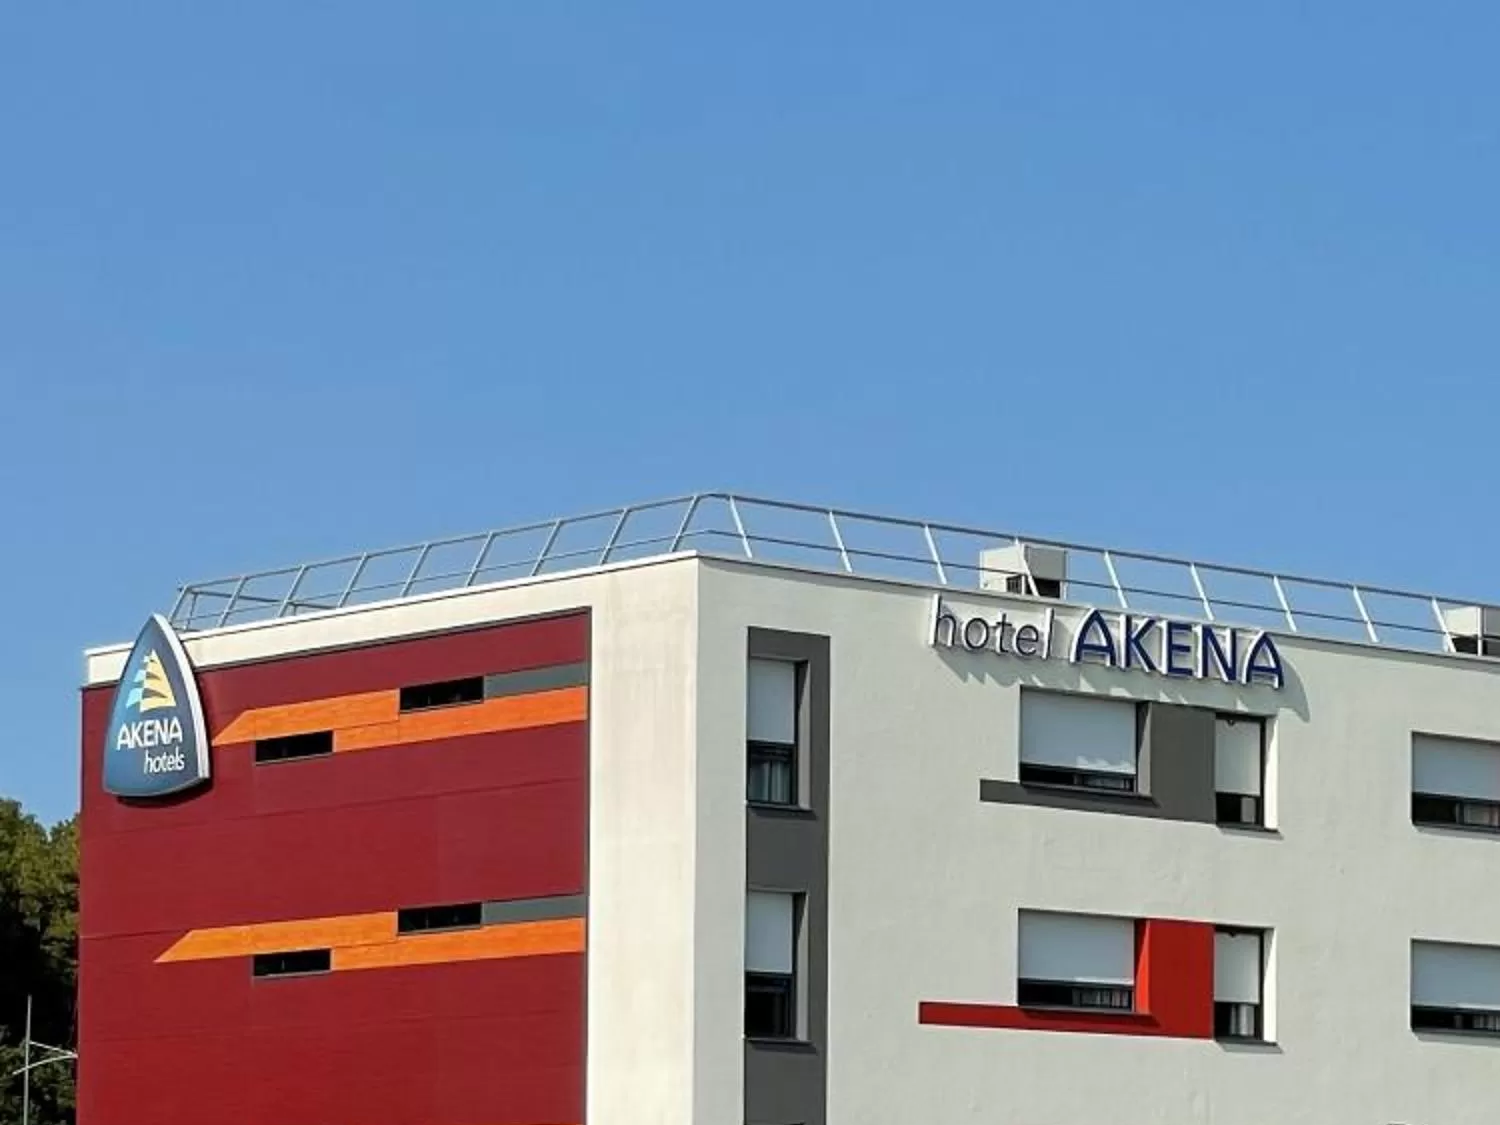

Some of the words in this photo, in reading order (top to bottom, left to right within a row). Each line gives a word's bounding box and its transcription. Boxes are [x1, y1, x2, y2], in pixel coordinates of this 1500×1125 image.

[929, 593, 1054, 660] hotel
[1069, 607, 1285, 690] AKENA
[116, 716, 183, 750] AKENA
[143, 747, 185, 774] hotels
